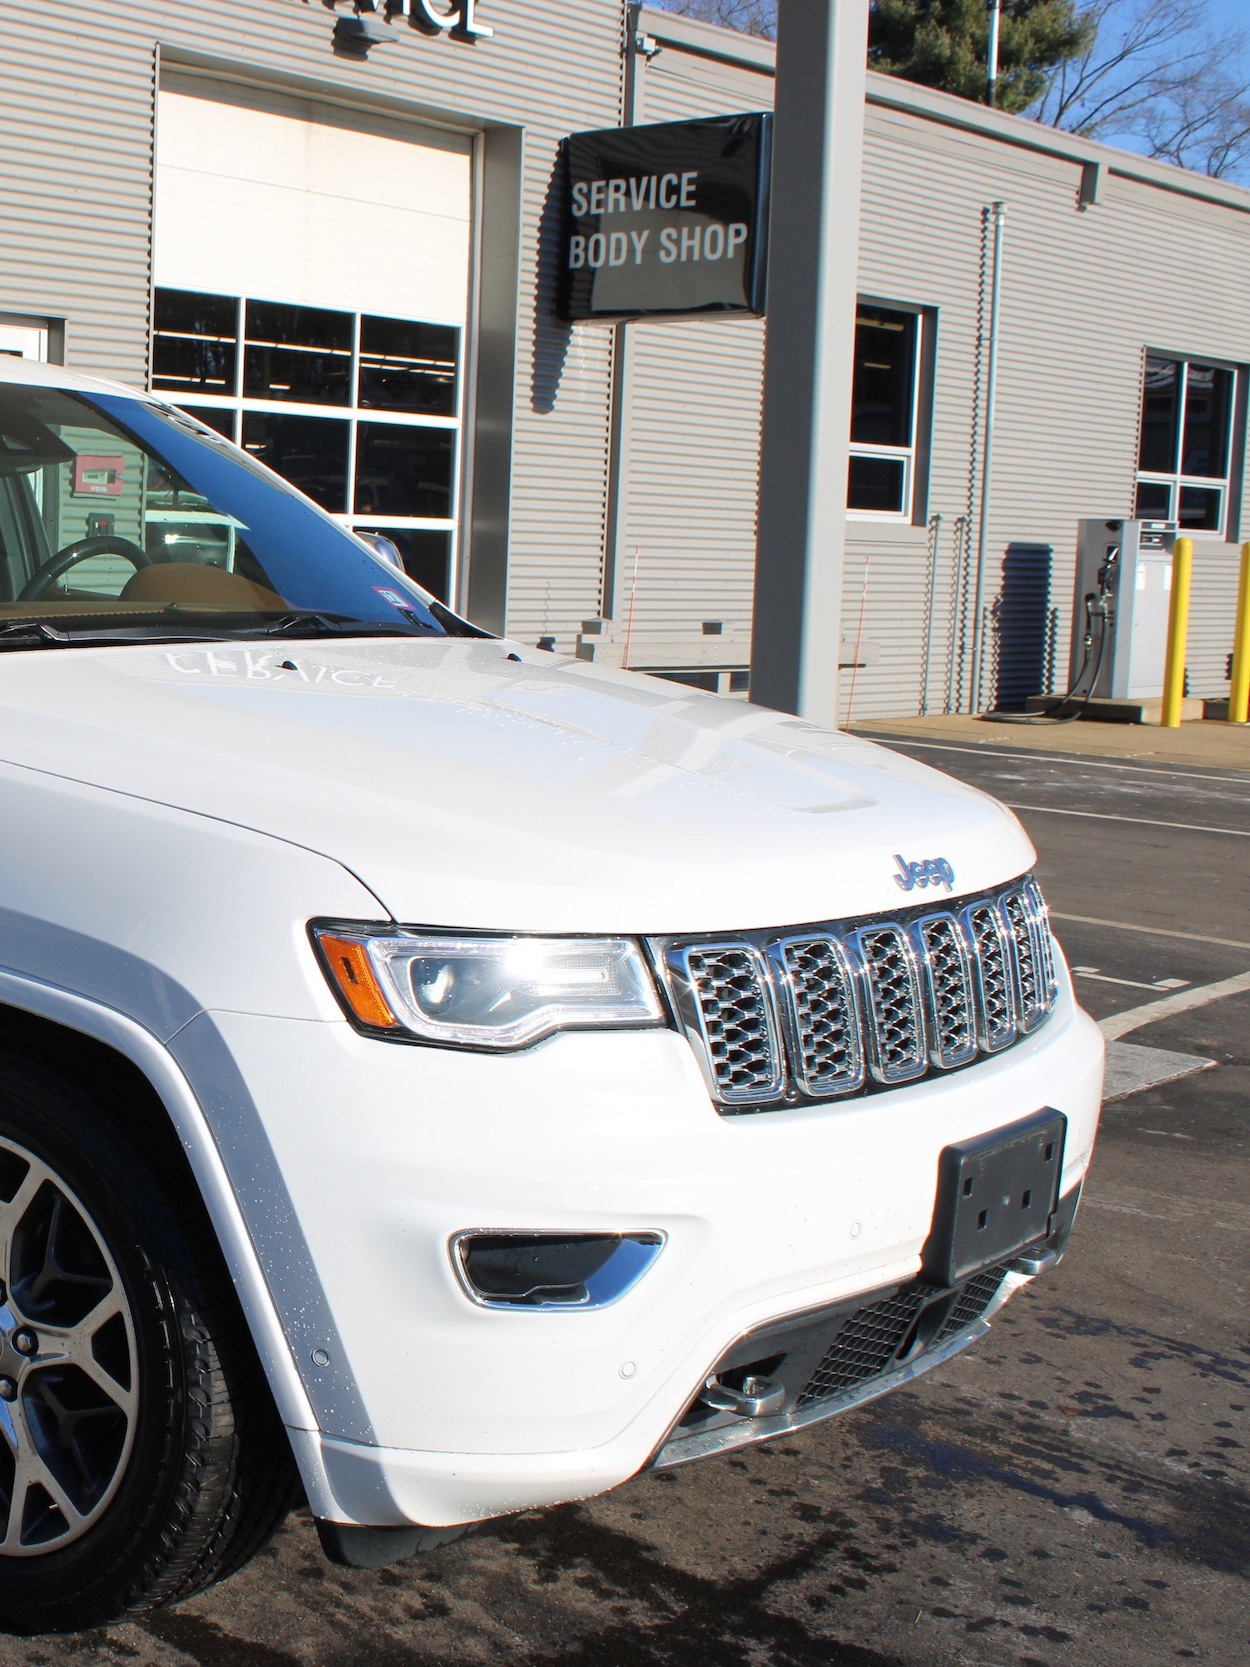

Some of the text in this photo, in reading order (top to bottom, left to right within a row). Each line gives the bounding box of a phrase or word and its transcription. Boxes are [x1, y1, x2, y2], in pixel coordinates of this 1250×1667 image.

[570, 171, 699, 218] SERVICE
[568, 222, 749, 269] BODY SHOP
[892, 854, 955, 892] Jeep
